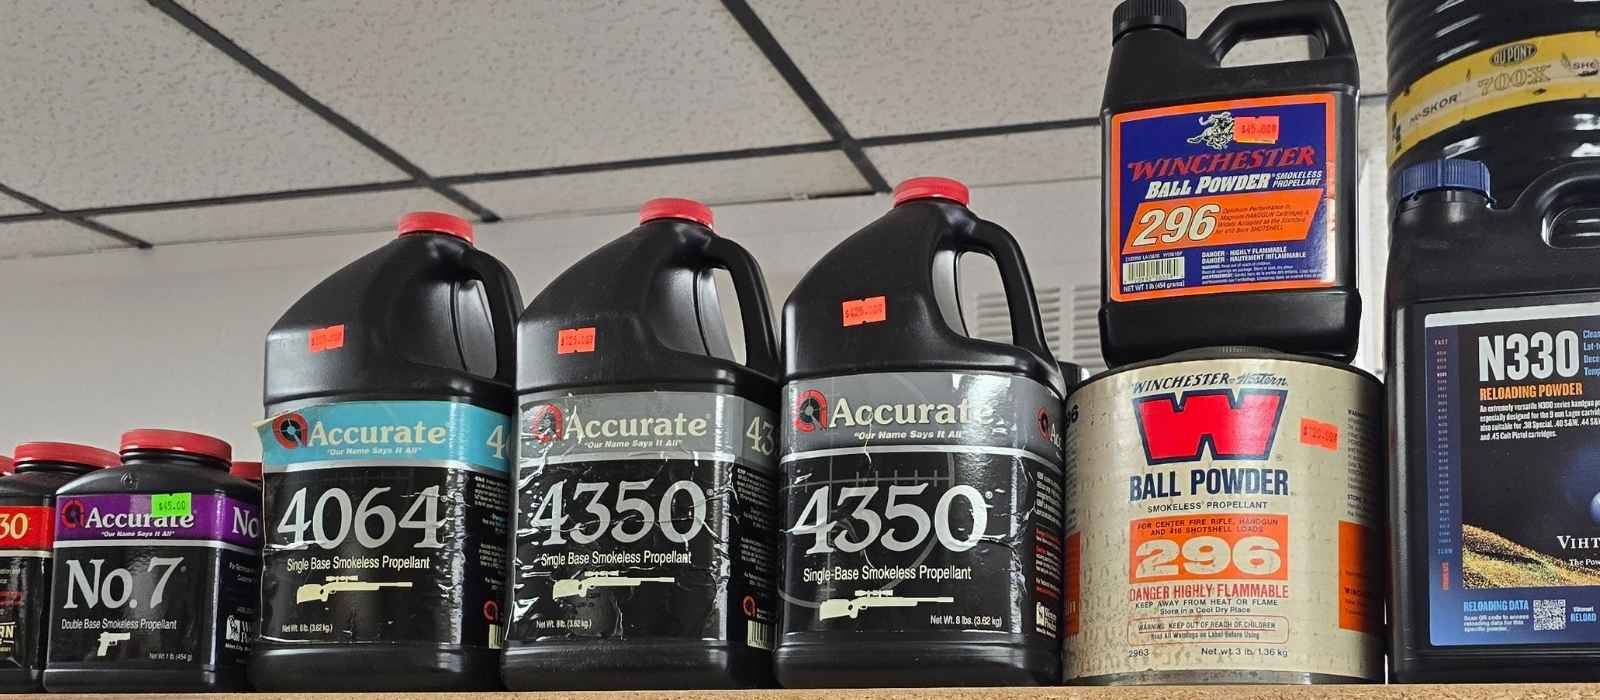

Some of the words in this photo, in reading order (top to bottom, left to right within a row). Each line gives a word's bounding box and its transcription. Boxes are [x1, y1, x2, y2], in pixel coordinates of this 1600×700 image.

[1478, 64, 1552, 97] 700X
[1127, 145, 1316, 182] WINCHESTER
[1145, 180, 1191, 200] BALL
[1195, 173, 1271, 195] POWDER
[1275, 170, 1322, 180] SMOKELESS
[1272, 179, 1321, 188] PROPELLANT
[1132, 203, 1220, 247] 296
[1230, 248, 1251, 256] HIGHLY
[1252, 246, 1287, 254] FLAMMABLE
[1478, 330, 1580, 382] N330
[1131, 372, 1230, 394] WINCHESTER
[1480, 385, 1537, 401] RELOADING
[1538, 382, 1584, 397] POWDER
[829, 397, 994, 429] Accurate
[1488, 403, 1513, 413] extremely
[1480, 414, 1505, 424] especially
[1507, 412, 1530, 421] designed
[308, 420, 447, 447] Accurate
[564, 411, 707, 441] Accurate
[1492, 422, 1513, 431] suitable
[1514, 421, 1522, 430] for
[878, 431, 907, 439] Name
[910, 430, 934, 440] Says
[937, 430, 945, 438] It
[1480, 432, 1490, 440] and
[346, 447, 368, 455] Name
[371, 447, 393, 456] Says
[605, 440, 630, 448] Name
[632, 439, 653, 449] Says
[1130, 471, 1181, 501] BALL
[1190, 468, 1289, 496] POWDER
[530, 478, 707, 546] 4350
[1148, 502, 1202, 513] SMOKELESS
[1207, 501, 1268, 509] PROPELLANT
[85, 507, 194, 529] Accurate
[277, 485, 448, 550] 4064
[791, 482, 988, 556] 4350
[1155, 519, 1185, 528] CENTER
[1185, 526, 1232, 534] SHOTSHELL
[287, 558, 309, 574] Single
[311, 557, 331, 570] Base
[333, 555, 380, 569] Smokeless
[382, 554, 430, 571] Propellant
[541, 553, 566, 568] Single
[568, 551, 589, 565] Base
[592, 550, 641, 564] Smokeless
[644, 550, 692, 566] Propellant
[1135, 536, 1281, 578] 296
[1569, 558, 1584, 568] The
[803, 566, 859, 584] Single-Base
[862, 565, 916, 580] Smokeless
[919, 564, 972, 582] Propellant
[64, 558, 138, 610] No.
[148, 557, 185, 610] 7
[1130, 585, 1169, 601] DANGER
[1174, 584, 1214, 599] HIGHLY
[1217, 584, 1289, 599] FLAMMABLE
[1160, 607, 1179, 615] Store
[1215, 606, 1228, 615] Dry
[1463, 600, 1507, 612] RELOADING
[1509, 599, 1529, 611] DATA
[61, 618, 83, 629] Double
[84, 618, 101, 629] Base
[102, 618, 139, 629] Smokeless
[140, 618, 177, 631] Propellant
[930, 615, 942, 625] Net
[961, 615, 973, 625] lbs.
[974, 615, 991, 626] (3.62
[991, 615, 1002, 626] kg)
[1244, 621, 1276, 629] CHILDREN
[1571, 613, 1597, 622] RELOAD
[1128, 648, 1149, 657] 2963
[1201, 647, 1217, 655] Net
[1277, 648, 1288, 657] kg
